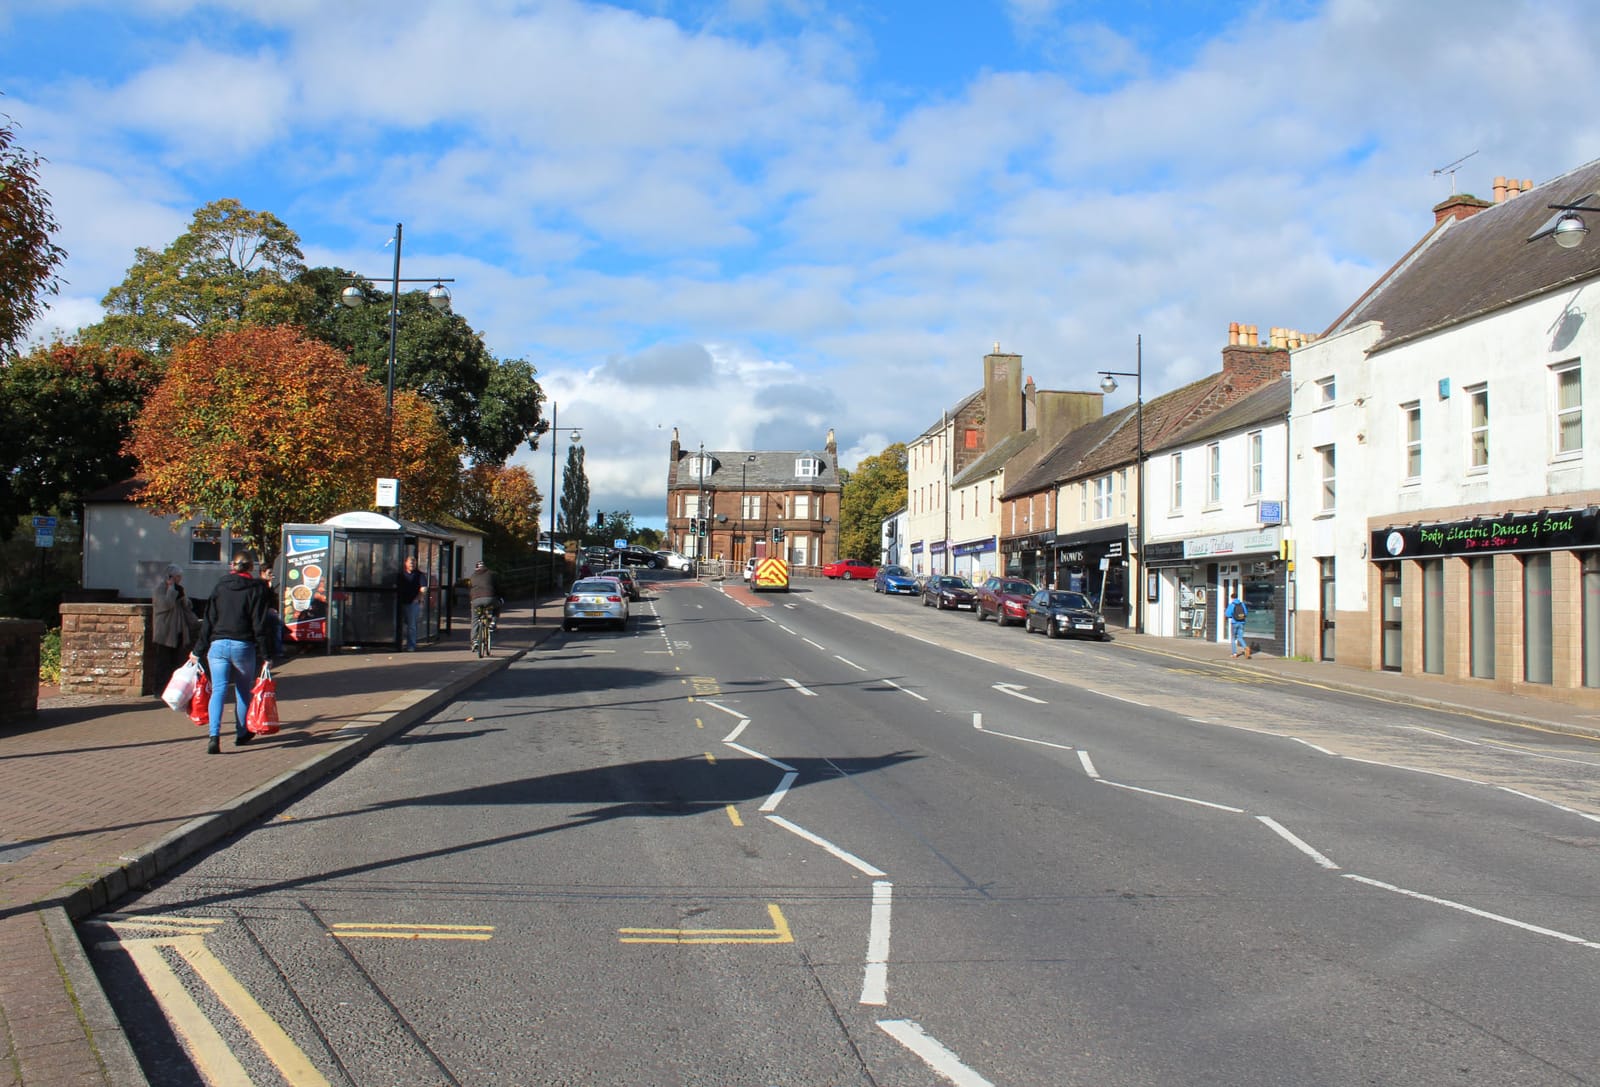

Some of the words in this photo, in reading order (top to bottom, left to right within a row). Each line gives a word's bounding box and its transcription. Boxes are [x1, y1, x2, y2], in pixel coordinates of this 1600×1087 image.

[1420, 529, 1444, 548] Body
[1447, 524, 1489, 541] Electric
[1491, 522, 1528, 538] Dance
[1532, 521, 1539, 537] &
[1542, 516, 1574, 532] Soul
[1465, 538, 1489, 549] Dace
[1491, 536, 1518, 547] Stuo
